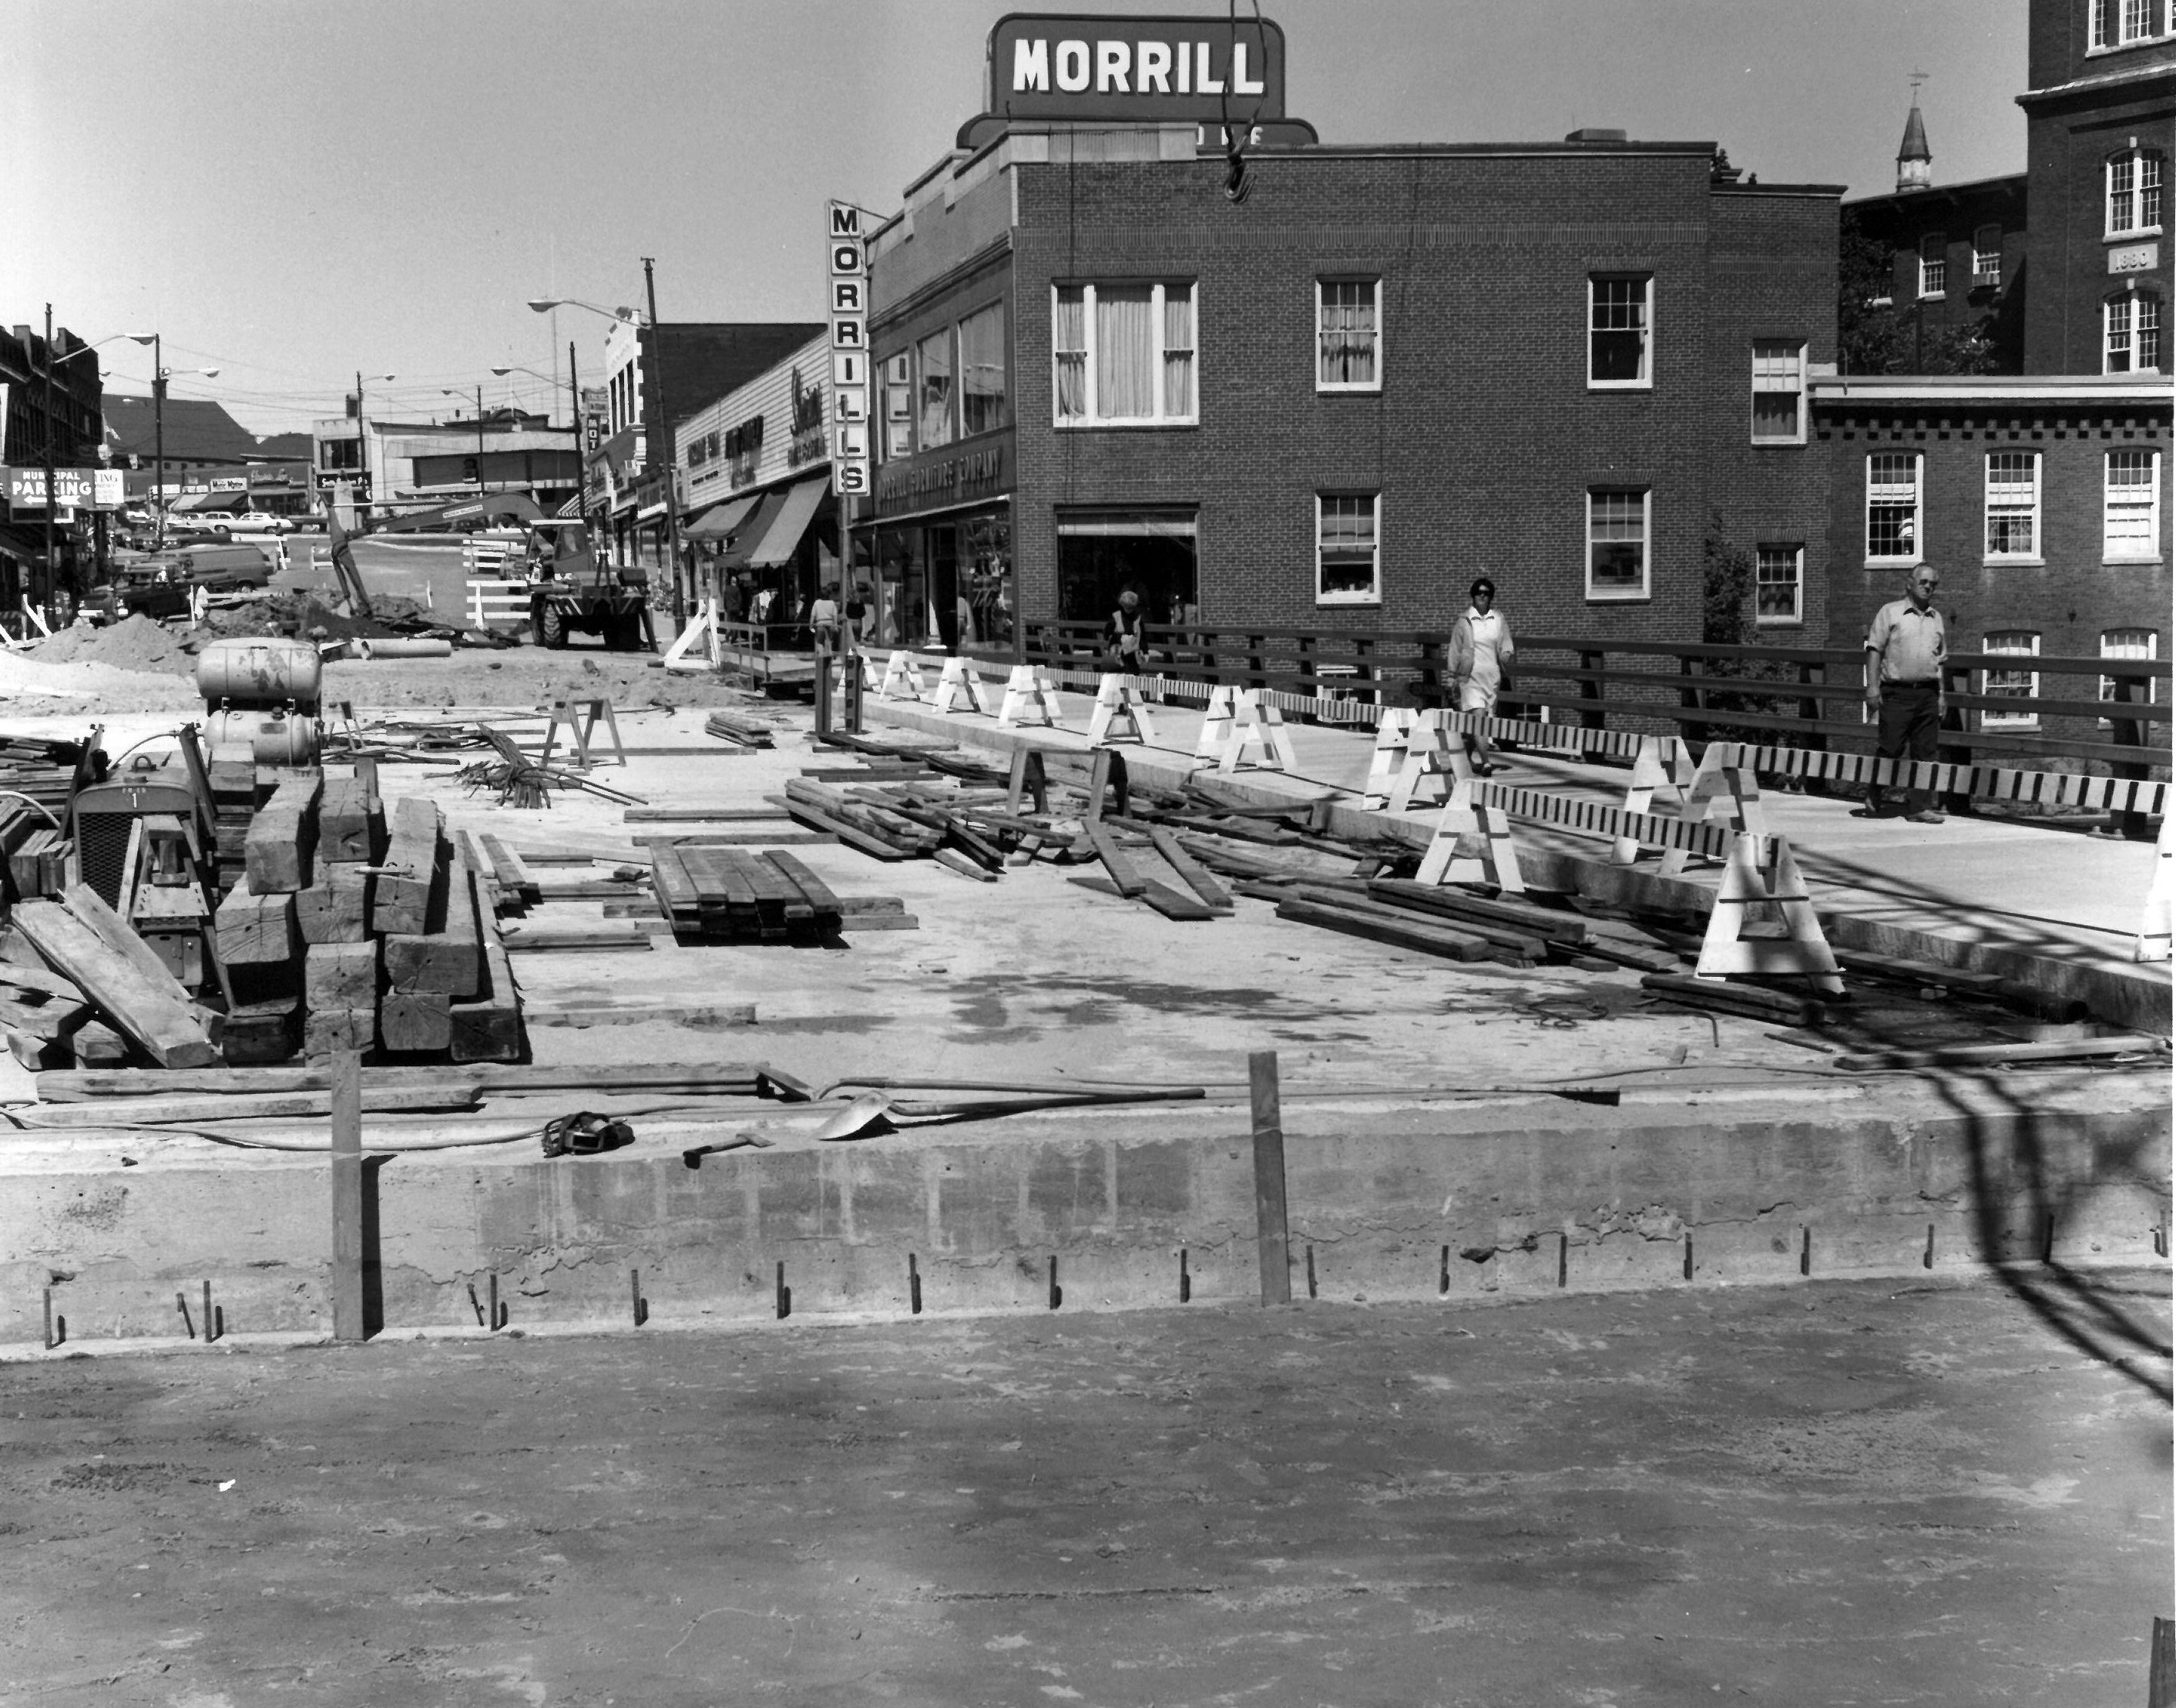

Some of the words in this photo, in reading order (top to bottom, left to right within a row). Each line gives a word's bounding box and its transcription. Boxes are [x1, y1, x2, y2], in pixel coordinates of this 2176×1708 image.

[1012, 39, 1264, 94] MORRILL
[833, 209, 863, 490] MORRILLS
[22, 471, 81, 481] MUNIPAL
[131, 792, 138, 808] 1
